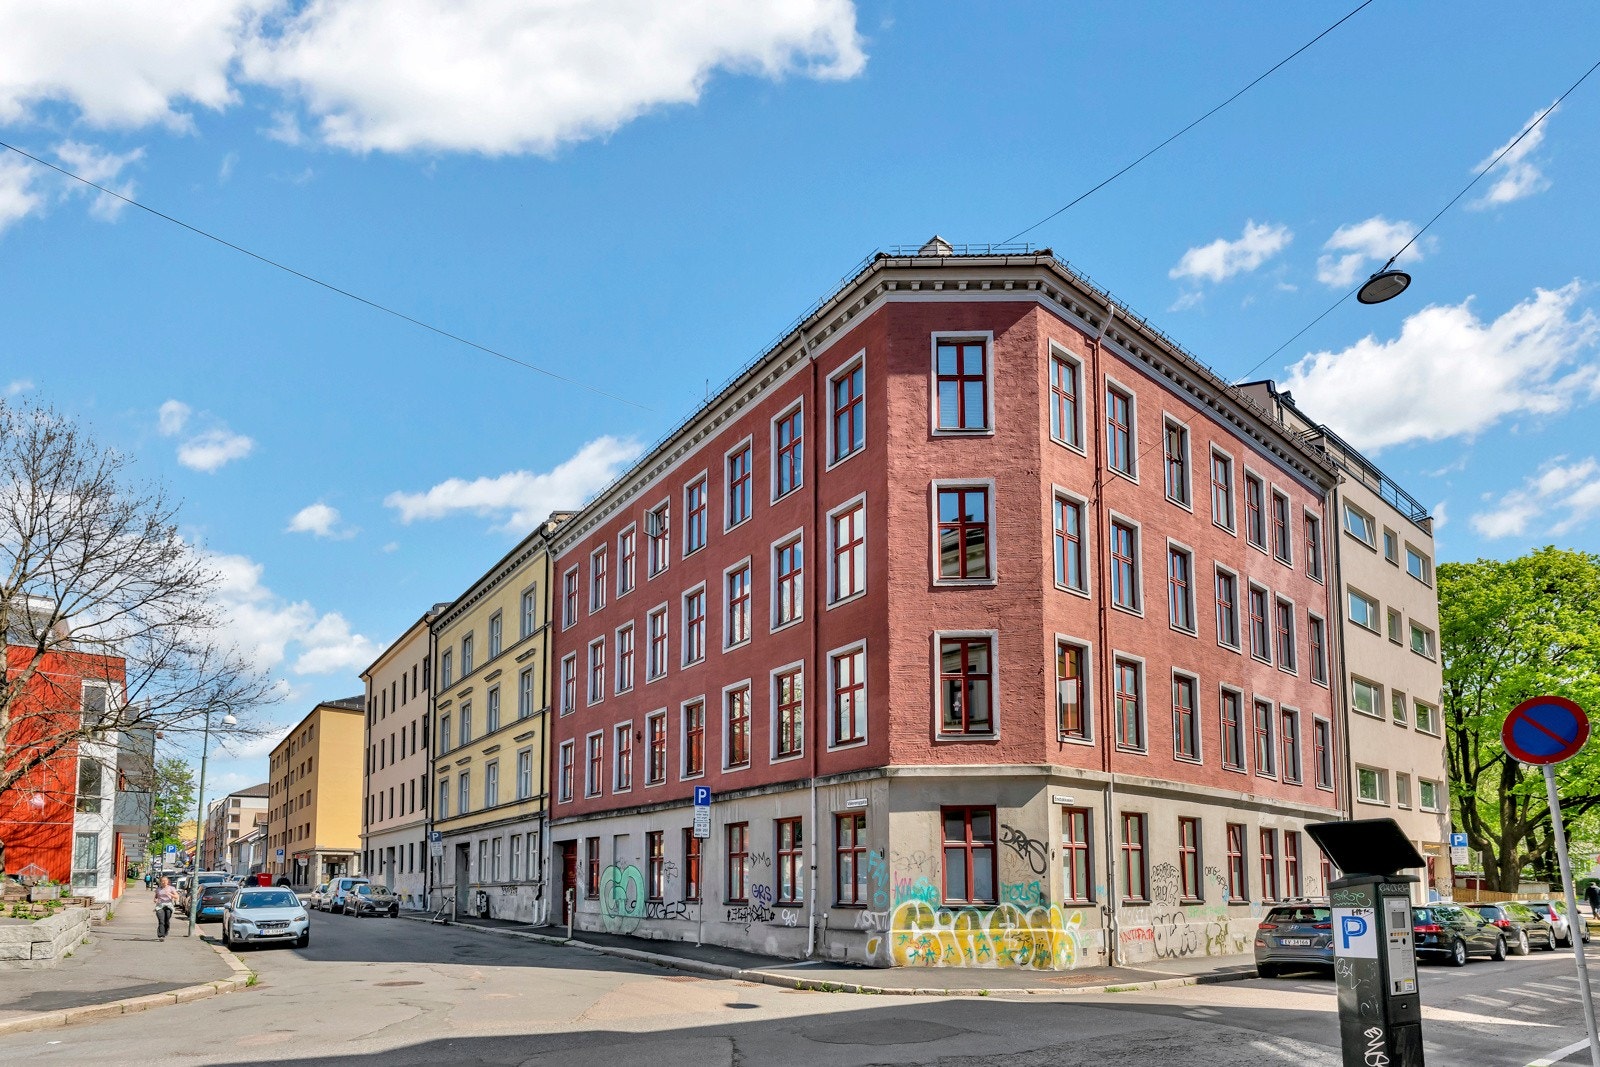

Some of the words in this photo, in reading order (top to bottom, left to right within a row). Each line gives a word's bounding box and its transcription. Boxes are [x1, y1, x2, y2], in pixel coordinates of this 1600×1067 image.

[698, 788, 707, 804] P
[1454, 834, 1464, 846] P
[1341, 915, 1368, 949] P
